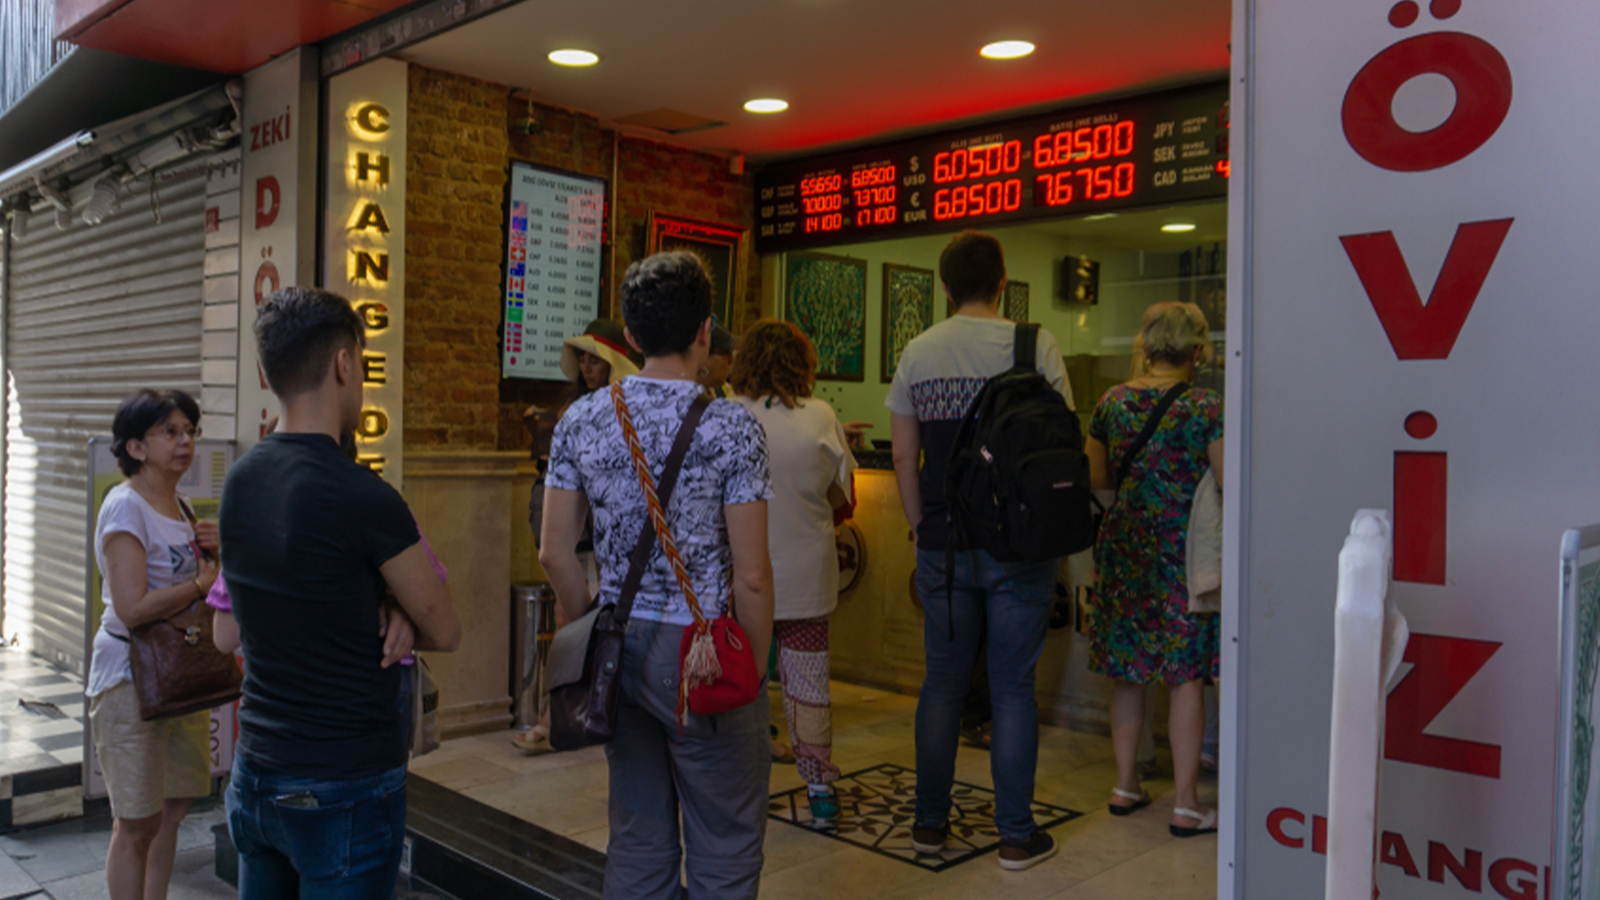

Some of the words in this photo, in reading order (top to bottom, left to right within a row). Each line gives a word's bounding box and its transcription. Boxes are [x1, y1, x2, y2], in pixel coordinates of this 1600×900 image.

[250, 104, 290, 153] ZEKİ
[1153, 121, 1175, 139] JPY
[1153, 145, 1176, 163] SEK
[903, 173, 926, 187] USD
[1154, 169, 1177, 186] CAD
[904, 209, 927, 223] EUR
